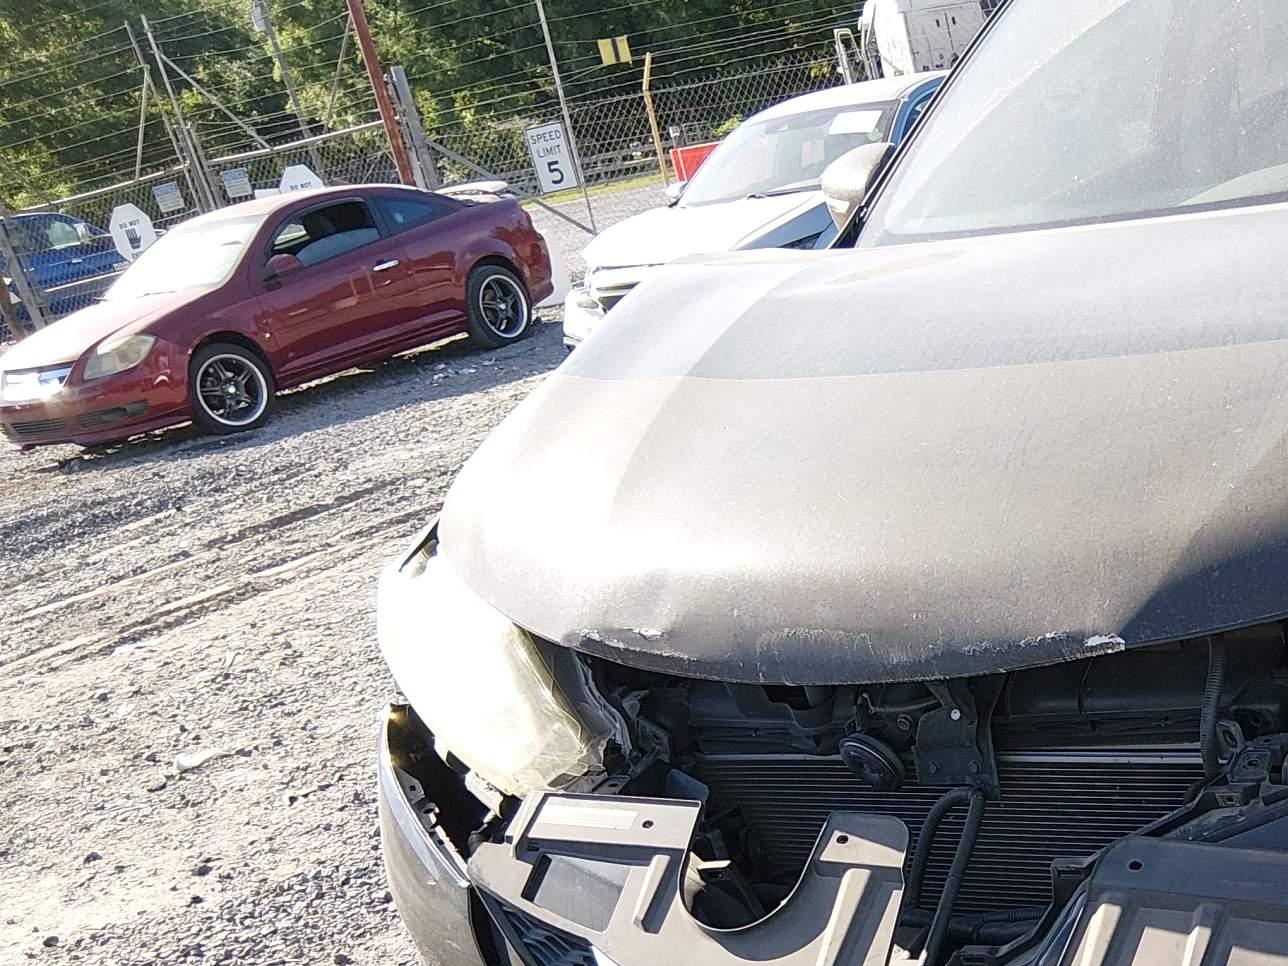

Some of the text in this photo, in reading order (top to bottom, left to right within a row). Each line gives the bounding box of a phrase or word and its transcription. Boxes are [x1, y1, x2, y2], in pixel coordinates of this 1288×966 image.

[530, 129, 562, 145] SPEED
[536, 144, 562, 158] LIMIT
[547, 160, 565, 185] 5
[300, 181, 312, 189] NOT
[118, 218, 141, 230] DO NOT
